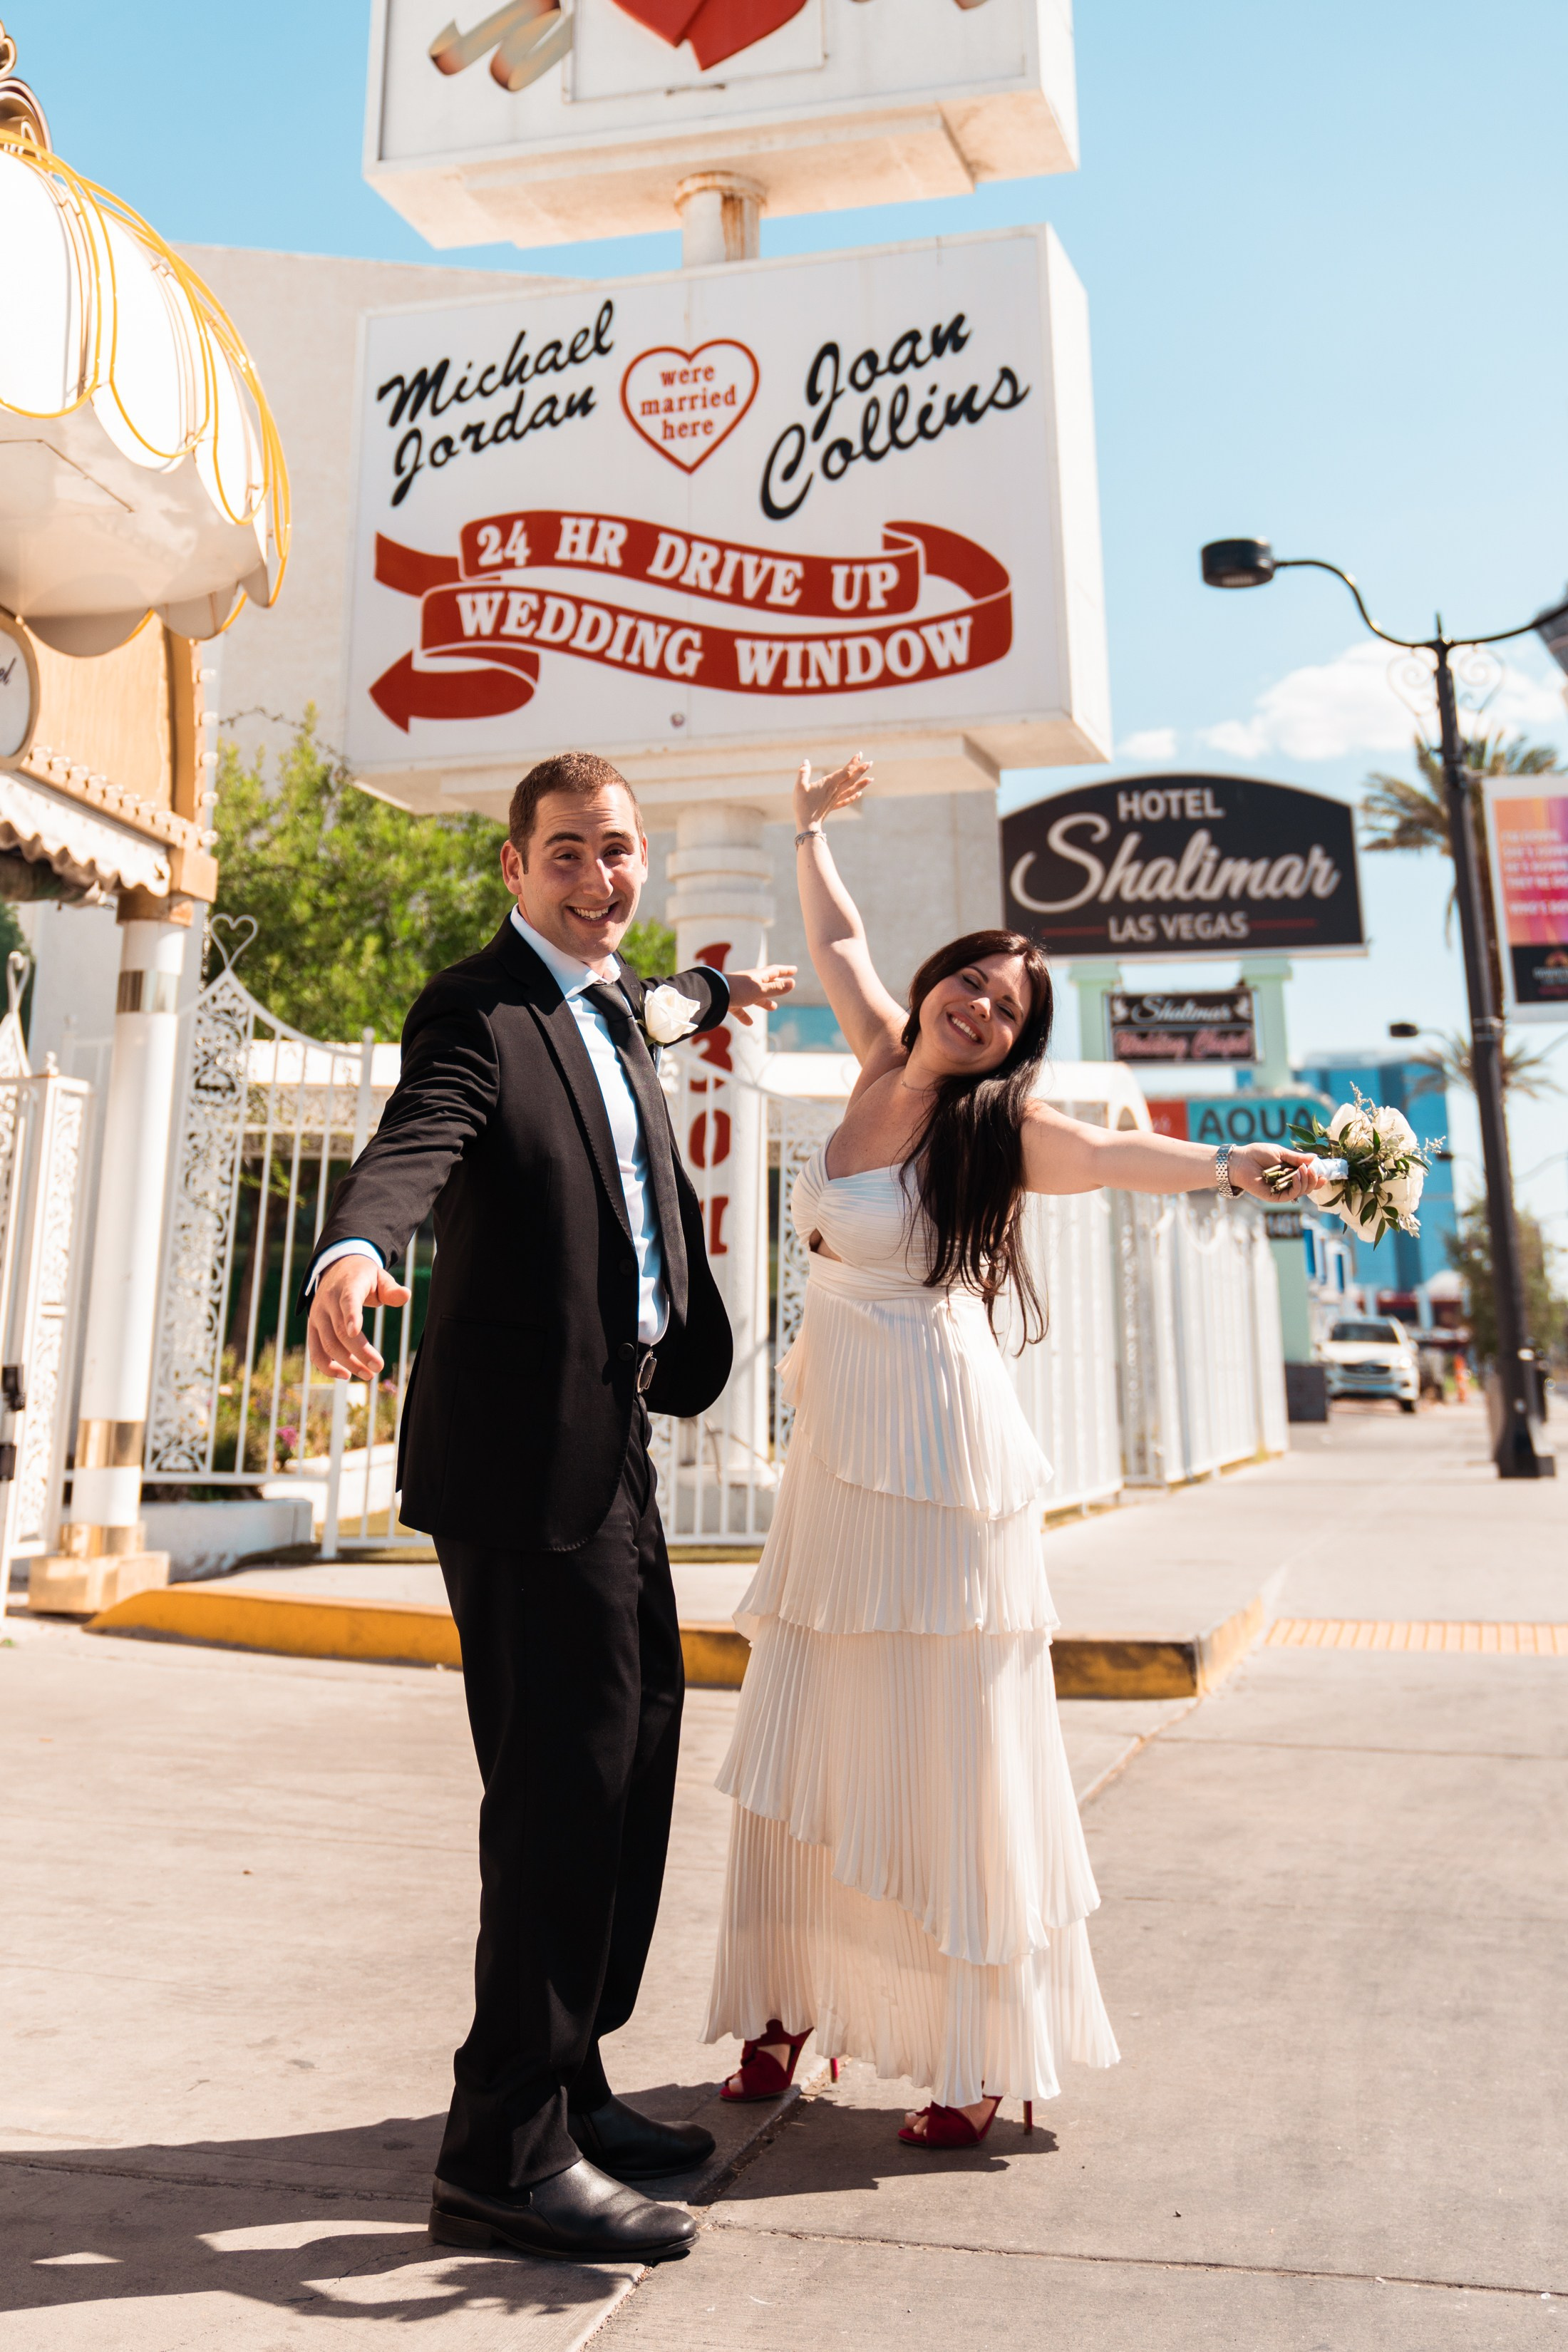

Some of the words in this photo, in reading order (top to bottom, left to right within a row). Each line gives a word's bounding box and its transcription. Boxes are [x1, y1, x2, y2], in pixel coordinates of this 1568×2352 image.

[376, 298, 614, 428] Michael
[640, 383, 737, 416] married
[660, 364, 715, 386] were
[805, 312, 973, 442] Joan
[390, 386, 597, 507] Jordan
[661, 418, 714, 440] here
[760, 366, 1031, 520] Collins
[476, 520, 531, 567] 24
[554, 517, 628, 568] HR
[646, 532, 804, 607] DRIVE
[831, 562, 899, 611] UP
[455, 591, 703, 678] WEDDING
[734, 615, 974, 688] WINDOW
[1117, 787, 1226, 822] HOTEL
[1009, 811, 1341, 914] Shalimar
[1109, 915, 1157, 943] LAS
[1160, 911, 1250, 942] VEGAS
